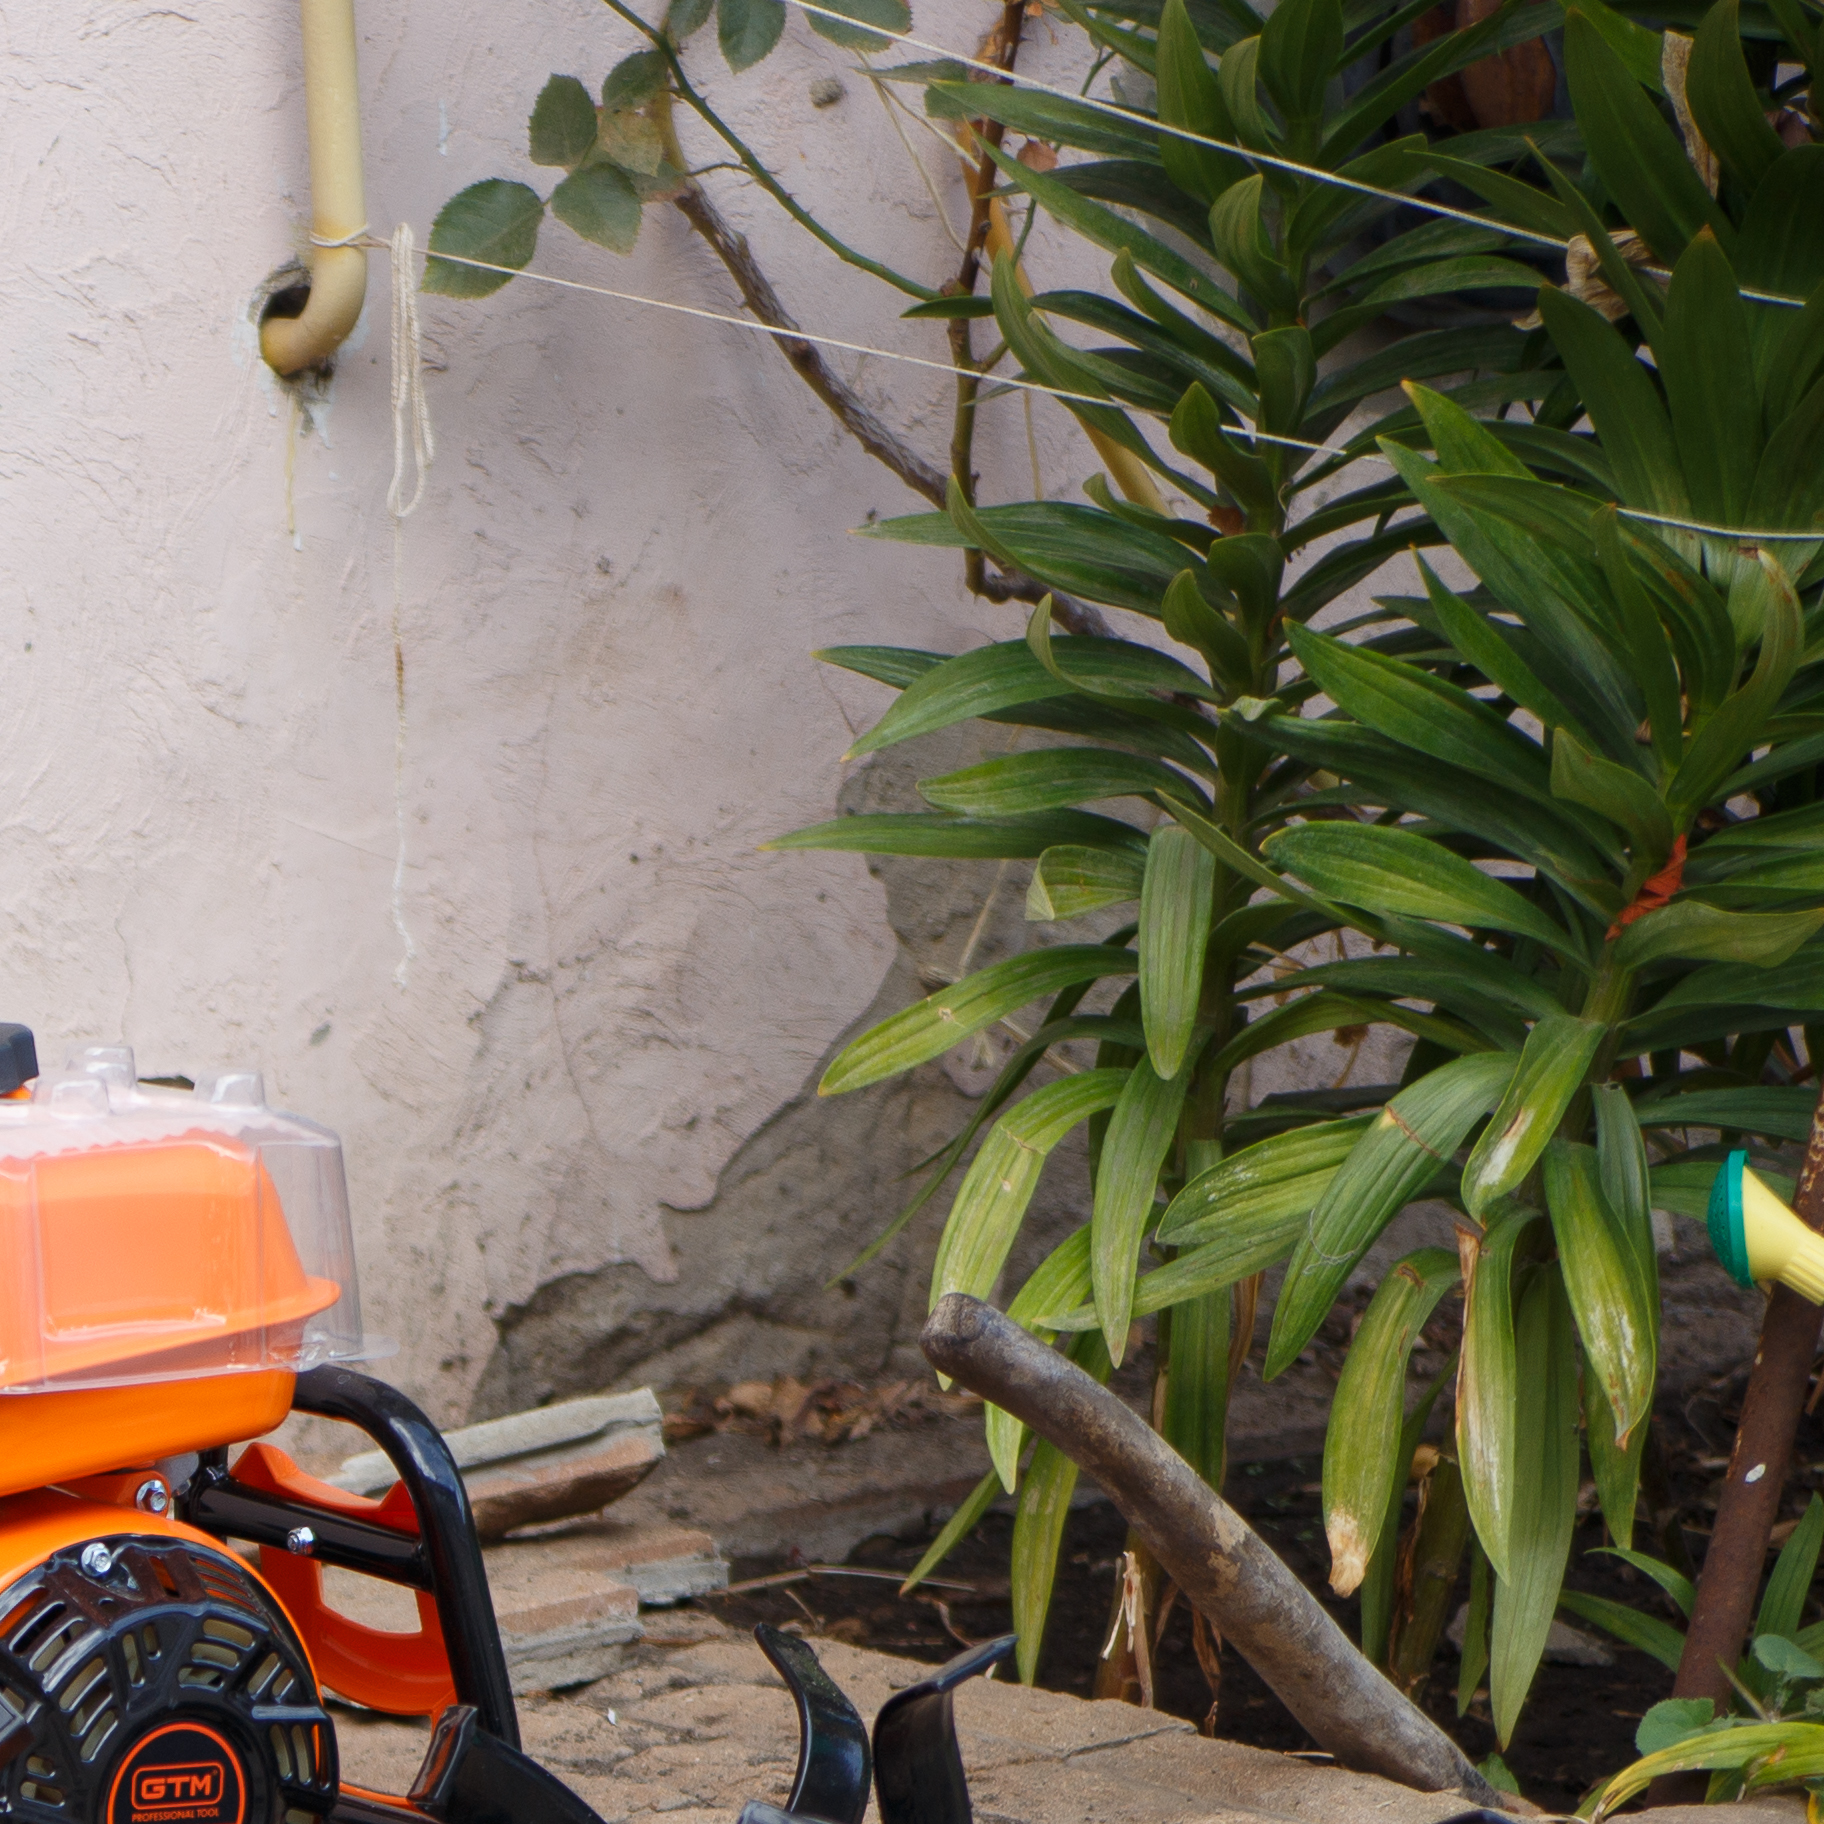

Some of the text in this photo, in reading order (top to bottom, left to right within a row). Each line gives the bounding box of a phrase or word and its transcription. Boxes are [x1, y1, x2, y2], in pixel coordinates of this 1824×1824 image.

[141, 1773, 212, 1800] GTM
[131, 1807, 220, 1823] PROFESSIONAL TOOL
